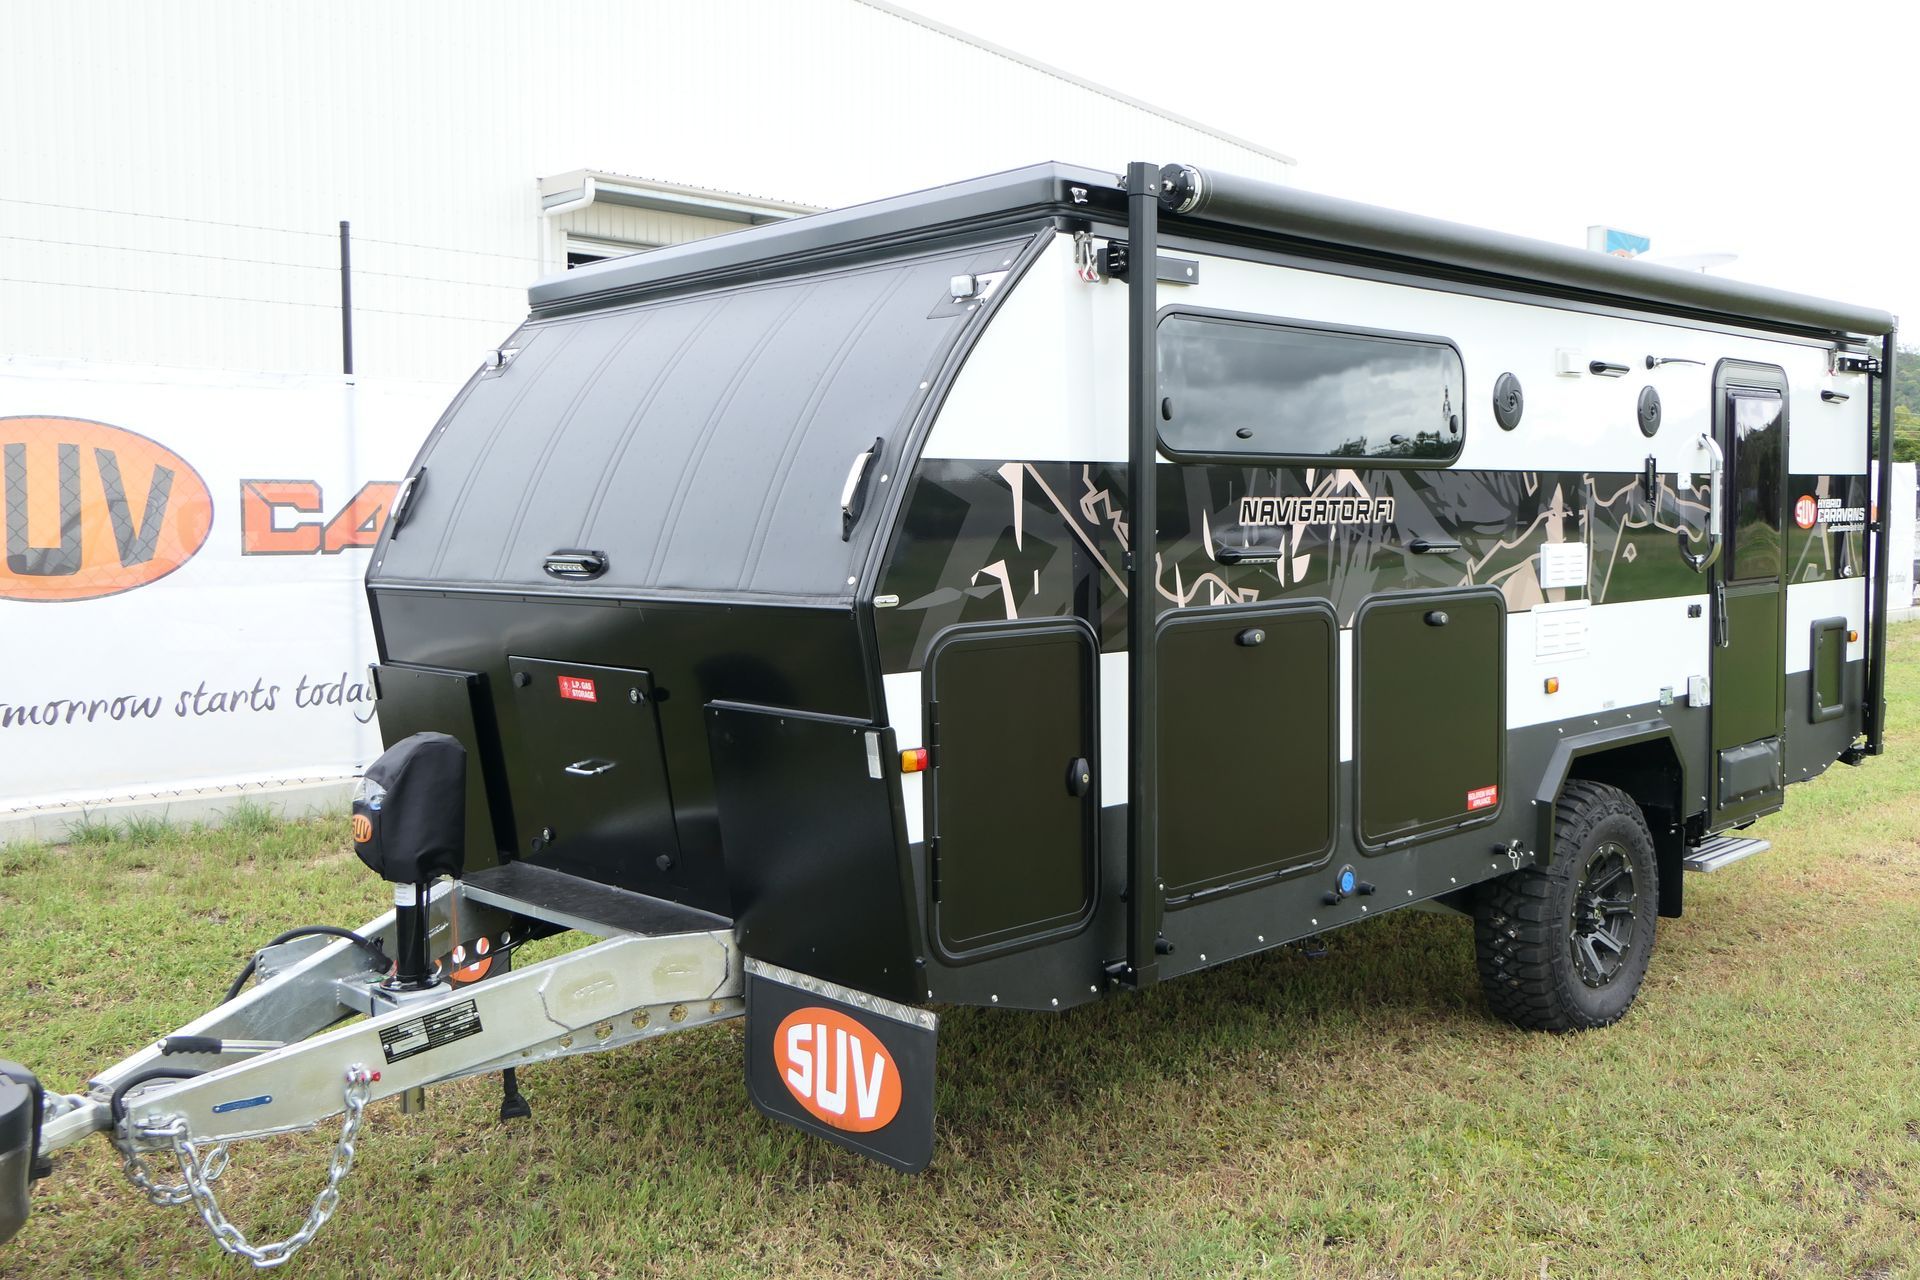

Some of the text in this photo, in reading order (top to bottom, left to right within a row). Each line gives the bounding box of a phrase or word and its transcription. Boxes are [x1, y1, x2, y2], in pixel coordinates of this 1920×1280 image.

[1240, 497, 1372, 526] NAVIGATOR
[1796, 499, 1815, 525] SUV
[1817, 498, 1842, 508] HYBRID
[1817, 507, 1866, 523] CARAVANS
[0, 695, 162, 728] morrow
[174, 677, 281, 718] starts
[572, 689, 595, 700] STORAGE
[787, 1023, 886, 1120] SUV
